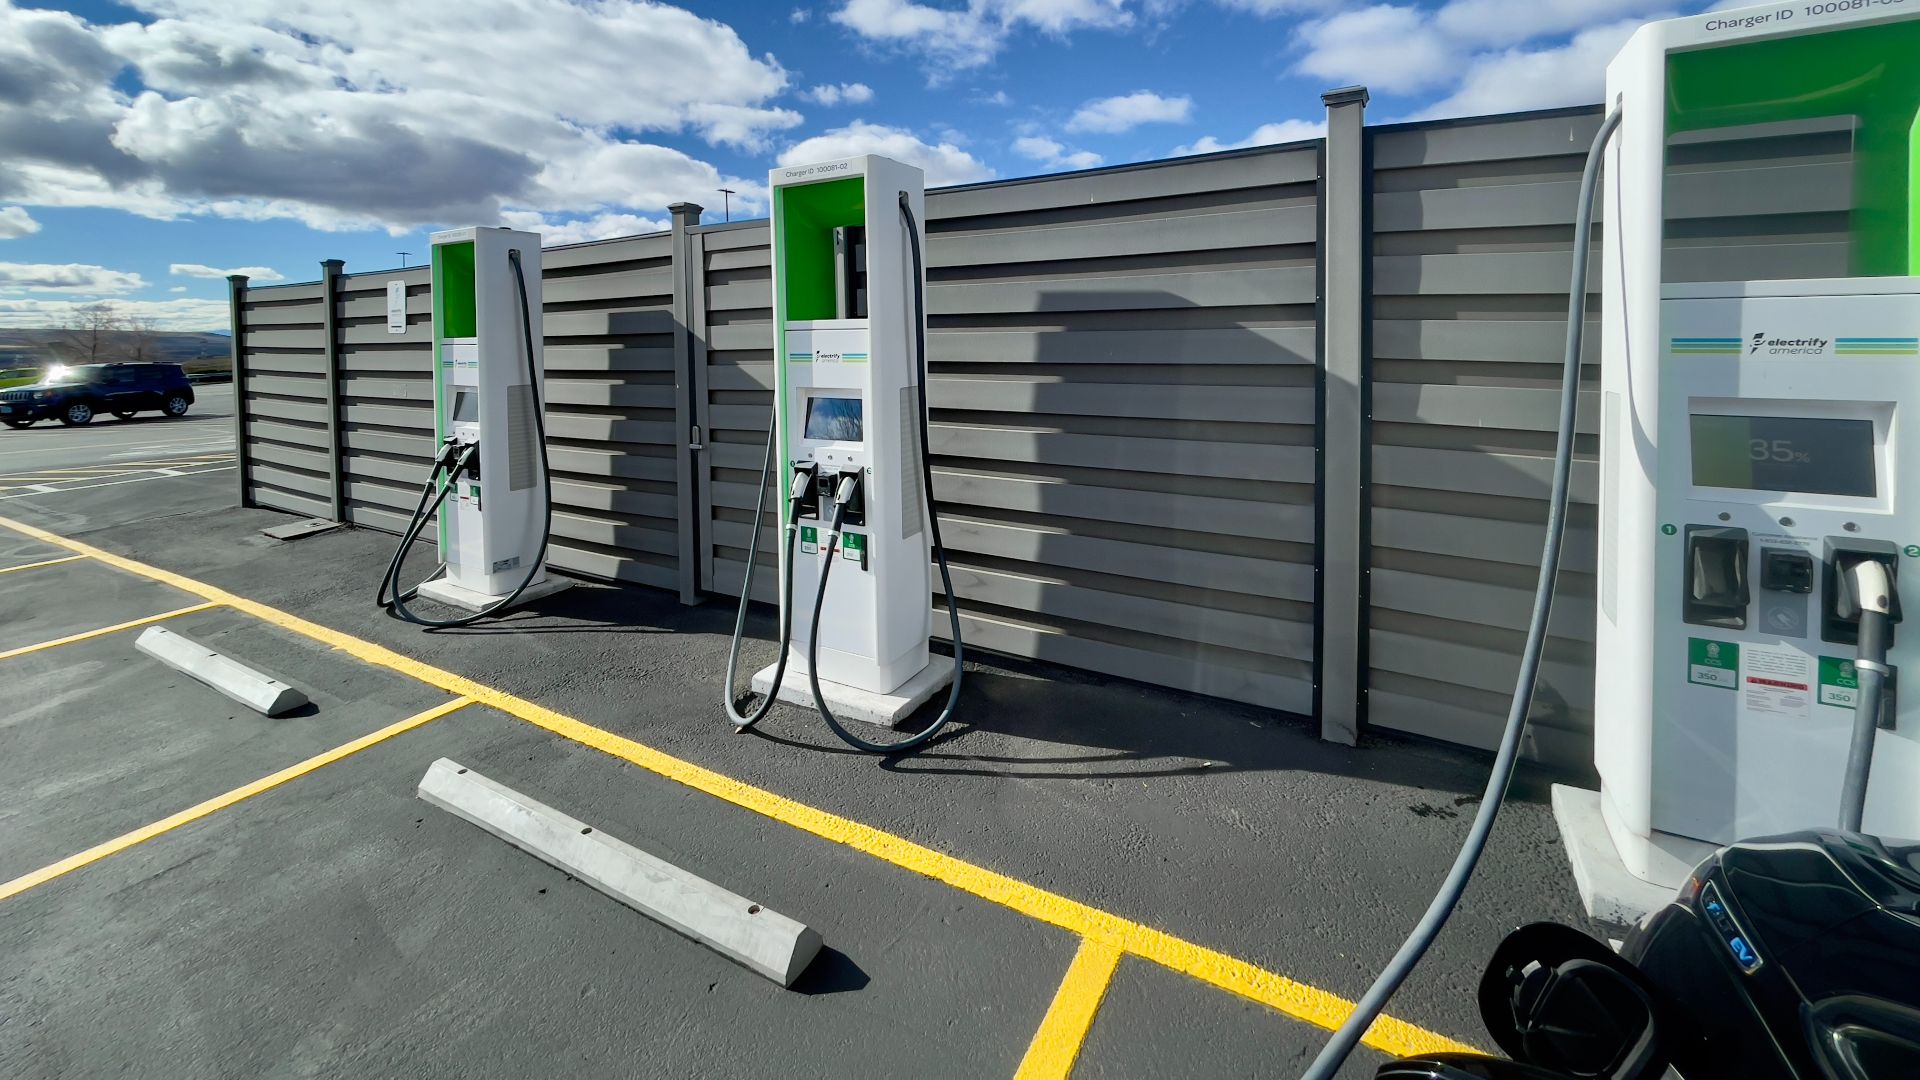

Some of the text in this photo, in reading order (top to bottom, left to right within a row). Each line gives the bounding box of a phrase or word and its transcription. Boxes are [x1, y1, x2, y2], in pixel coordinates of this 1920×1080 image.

[1705, 0, 1904, 31] Charger ID 100081-
[785, 169, 807, 178] Charger
[816, 162, 848, 173] 100081-02
[1767, 337, 1828, 348] electrify
[1768, 346, 1823, 355] america
[1696, 672, 1718, 681] 350
[1828, 692, 1851, 702] 350
